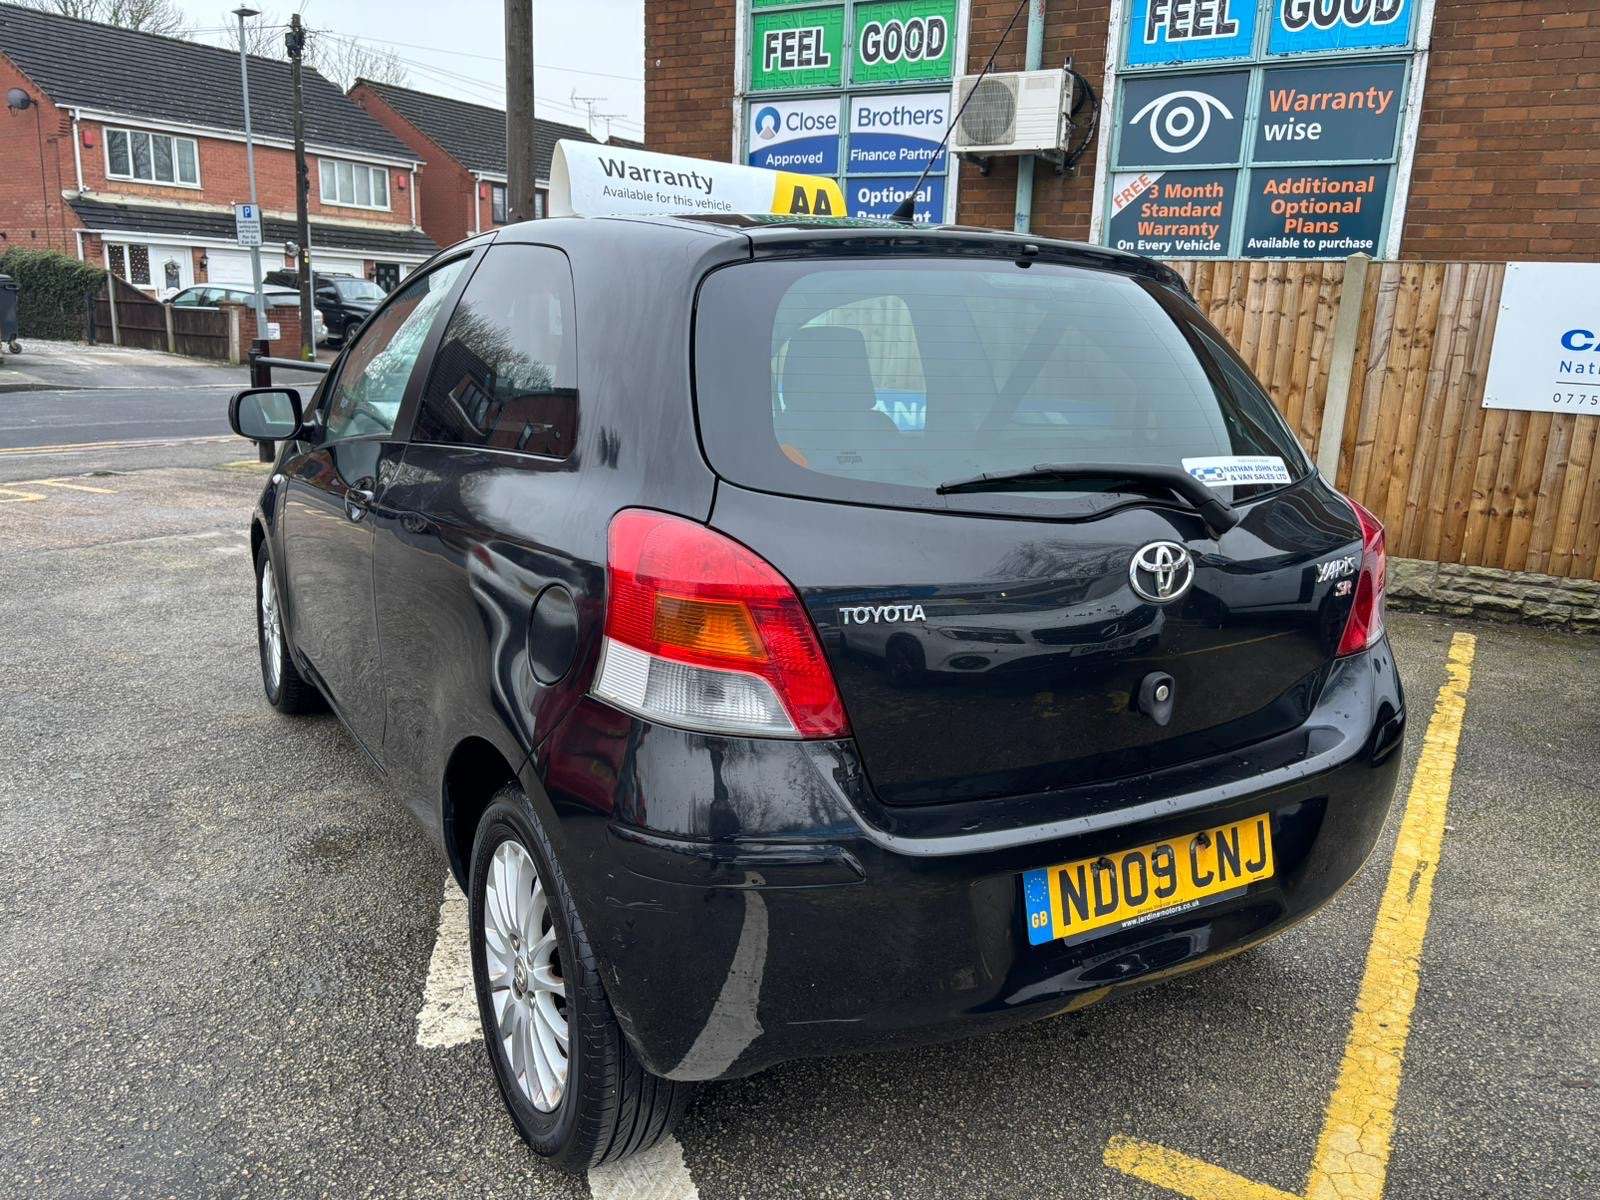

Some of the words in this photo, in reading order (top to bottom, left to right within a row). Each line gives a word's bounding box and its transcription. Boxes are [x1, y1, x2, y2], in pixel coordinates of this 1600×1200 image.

[1145, 0, 1239, 43] FEEL
[1281, 0, 1401, 31] GOOD
[763, 27, 831, 71] FEEL
[861, 17, 947, 65] GOOD
[1269, 86, 1394, 115] Warranty
[786, 111, 837, 131] Close
[857, 106, 944, 127] Brothers
[1263, 117, 1322, 141] wise
[765, 151, 824, 167] Approved
[850, 148, 896, 162] Finance
[899, 147, 945, 161] Partner
[598, 156, 714, 195] Warranty
[1263, 176, 1376, 195] Additional
[602, 184, 654, 202] Available
[656, 193, 672, 204] for
[674, 194, 693, 207] this
[695, 198, 732, 212] vehicle
[789, 185, 833, 216] AA
[1113, 172, 1152, 209] FREE
[1149, 184, 1159, 199] 3
[1165, 182, 1224, 199] Month
[1141, 201, 1223, 217] Standard
[1270, 197, 1362, 218] Optional
[1137, 221, 1220, 239] Warranty
[1284, 218, 1340, 233] Plans
[1117, 240, 1135, 250] On
[1138, 240, 1172, 252] Every
[1175, 240, 1222, 251] Vehicle
[1247, 237, 1300, 249] Available
[1303, 238, 1316, 249] to
[1318, 238, 1374, 251] purchase
[1559, 360, 1600, 375] Nat
[1223, 465, 1254, 473] NATHAN
[1334, 580, 1353, 597] SR
[838, 604, 928, 625] TOYOTA
[1058, 843, 1178, 928] ND09
[1190, 820, 1268, 888] CNJ
[1031, 910, 1048, 929] GB
